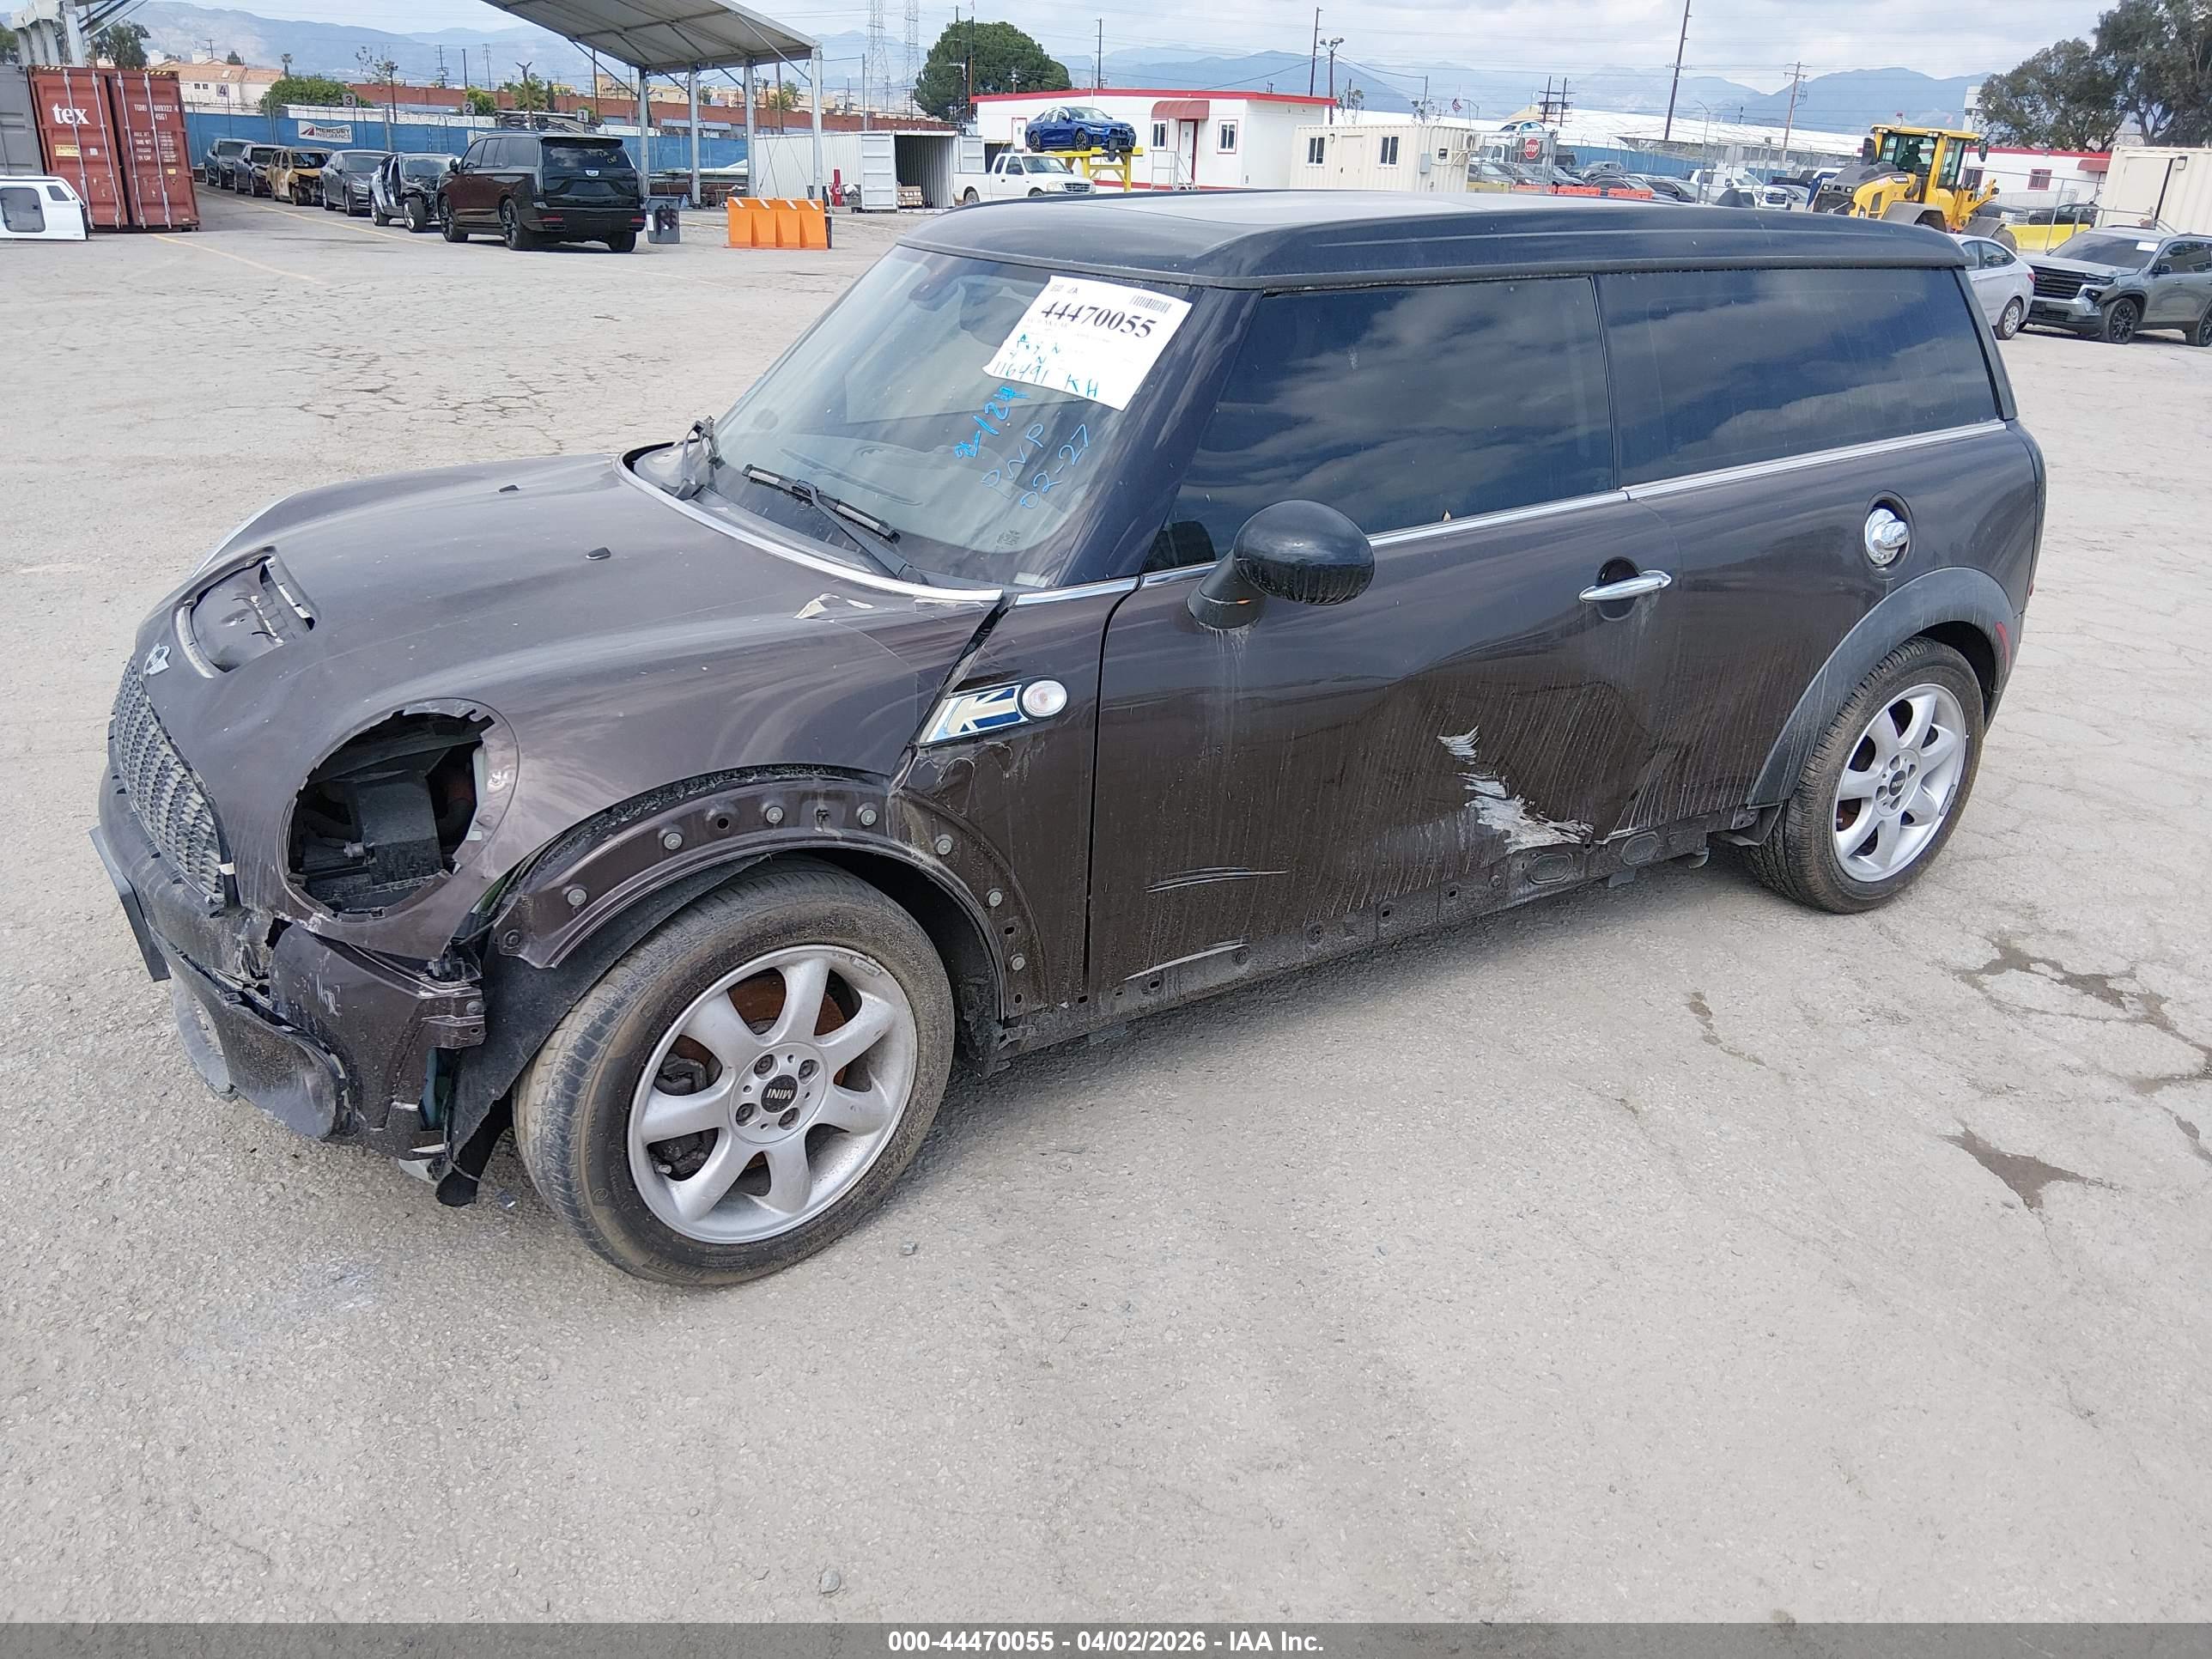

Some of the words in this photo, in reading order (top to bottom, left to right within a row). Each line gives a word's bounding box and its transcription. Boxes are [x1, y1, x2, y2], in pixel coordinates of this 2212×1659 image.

[219, 86, 227, 95] 4
[345, 95, 353, 105] 3
[465, 103, 471, 112] 2
[52, 103, 90, 125] tex
[580, 112, 586, 120] 1
[1041, 301, 1158, 338] 44470055
[1020, 423, 1089, 508] 02-27
[767, 1088, 794, 1100] MINI
